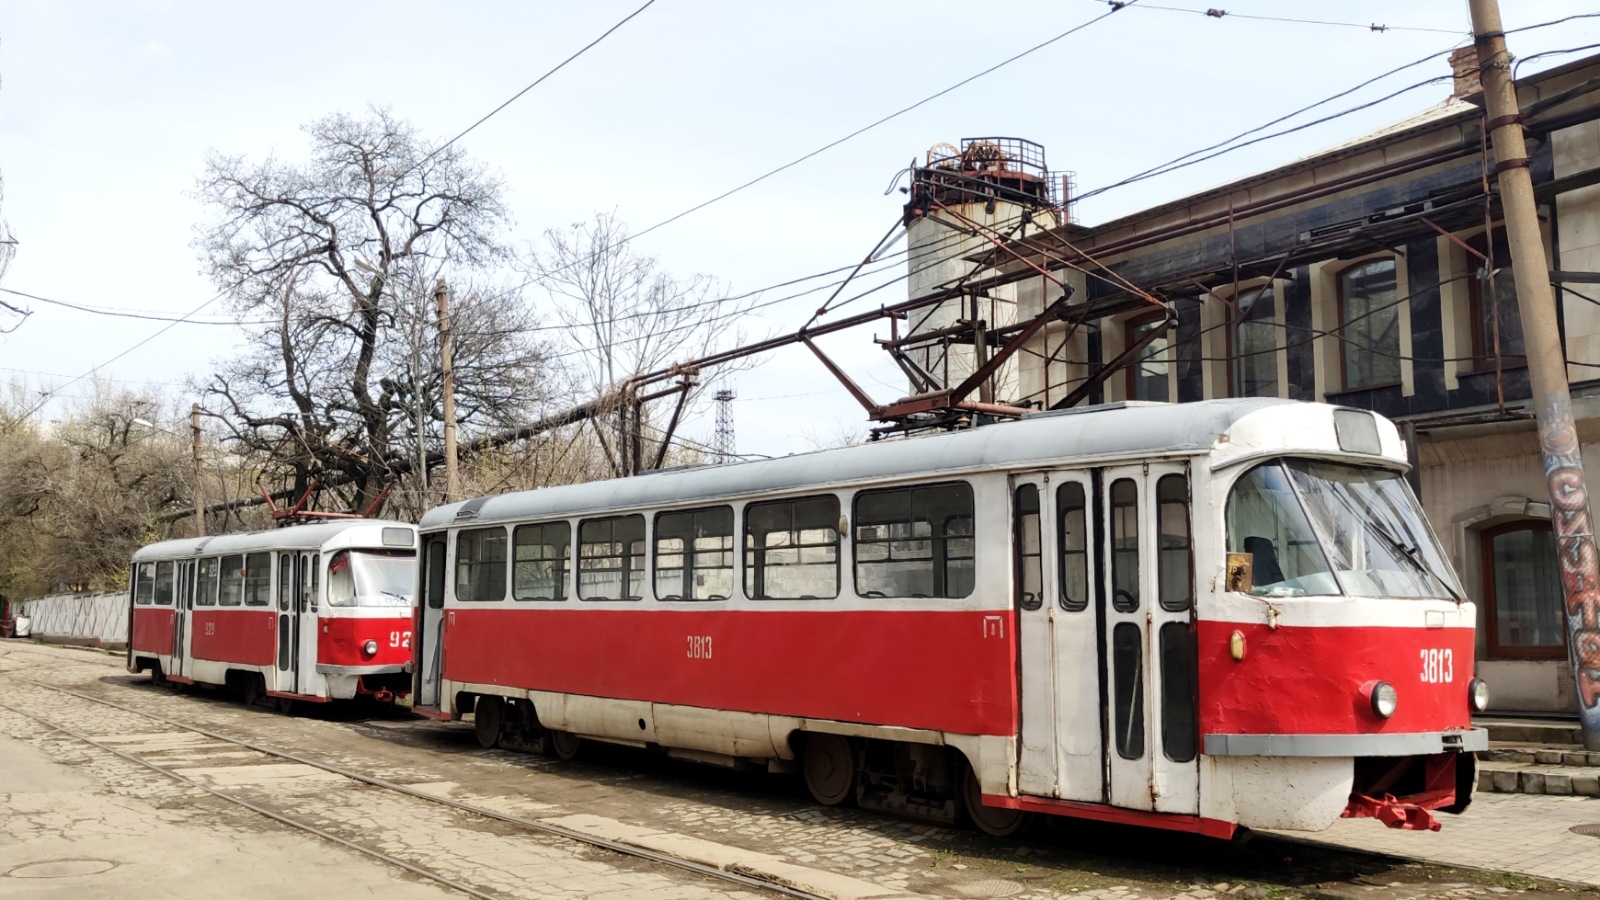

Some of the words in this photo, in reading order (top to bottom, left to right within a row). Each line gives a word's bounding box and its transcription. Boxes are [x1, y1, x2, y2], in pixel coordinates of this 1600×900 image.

[389, 631, 412, 648] 92
[687, 635, 712, 659] 3813
[1420, 648, 1453, 684] 3813
